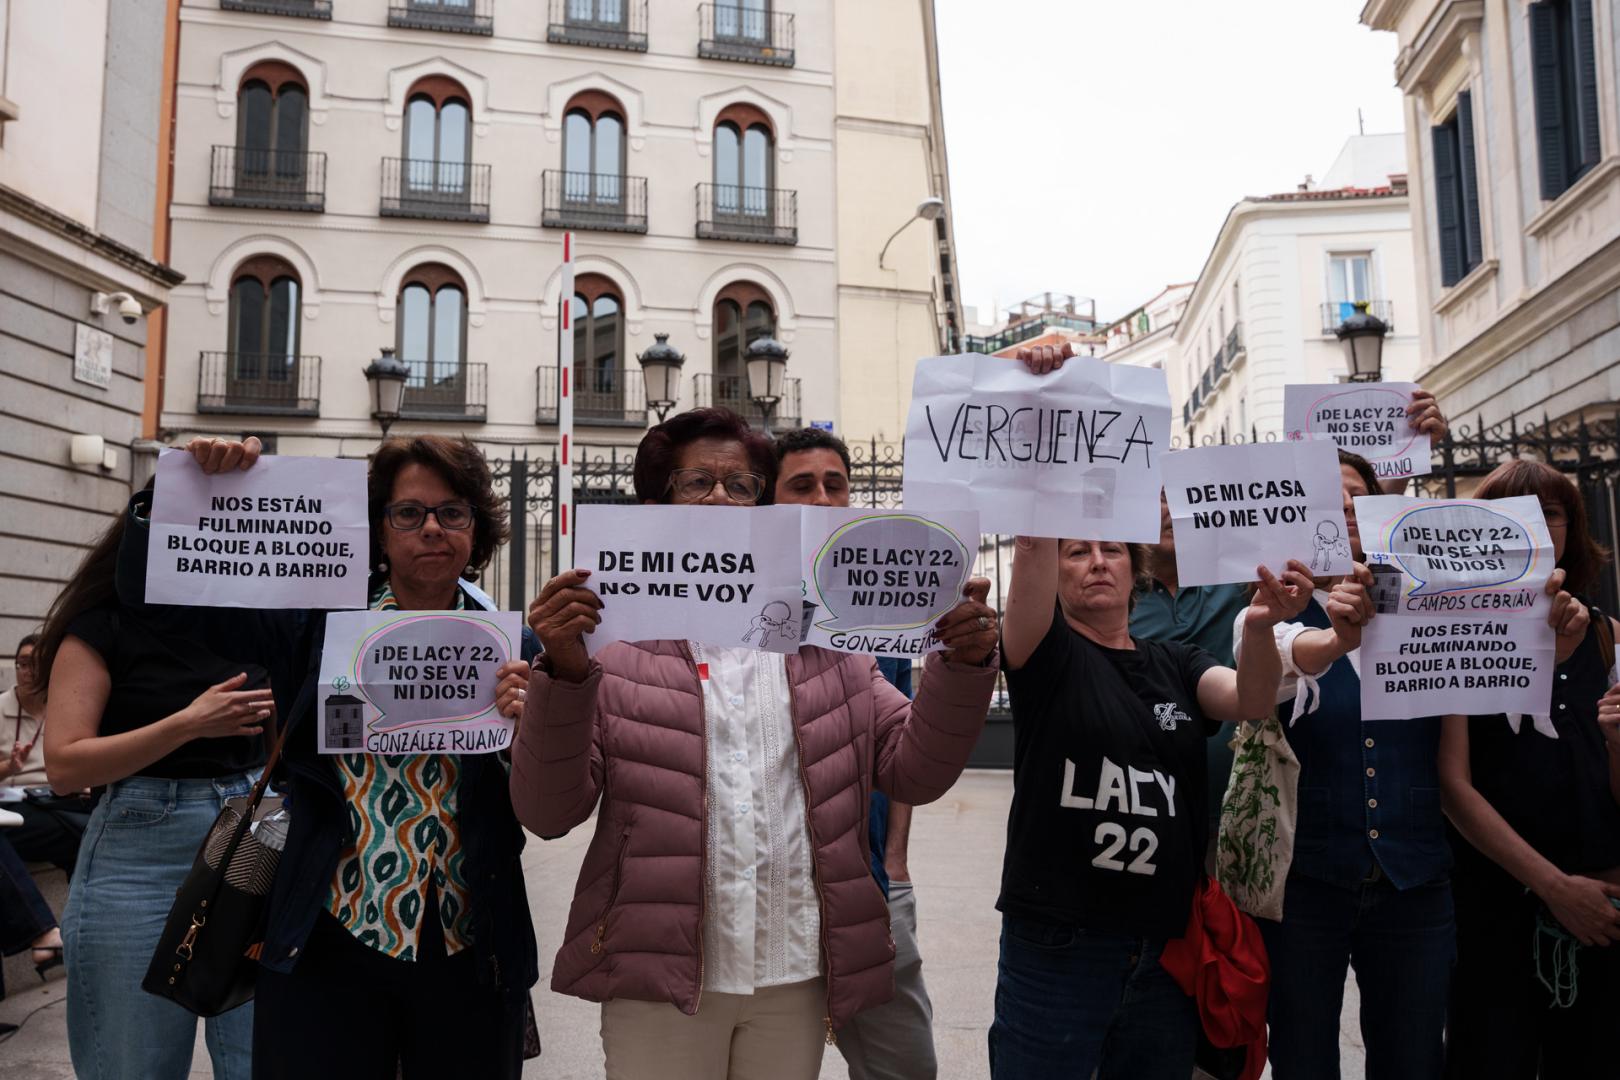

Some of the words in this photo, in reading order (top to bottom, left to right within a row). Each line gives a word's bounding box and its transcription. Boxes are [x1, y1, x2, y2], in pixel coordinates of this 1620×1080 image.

[1317, 409, 1341, 422] ¡DE
[1345, 408, 1383, 419] LACY
[1327, 422, 1349, 433] NO
[1352, 421, 1370, 432] SE
[1374, 421, 1395, 432] VA
[1351, 434, 1392, 446] DIOS!
[1186, 485, 1218, 504] DE
[1220, 484, 1244, 501] MI
[1248, 480, 1306, 500] CASA
[211, 496, 253, 512] NOS
[258, 495, 322, 513] ESTÁN
[198, 517, 332, 535] FULMINANDO
[1193, 510, 1226, 529] NO
[1230, 509, 1259, 527] ME
[1263, 506, 1307, 525] VOY
[1403, 526, 1432, 542] ¡DE
[1437, 528, 1483, 542] LACY
[1490, 527, 1519, 541] 22,
[167, 535, 250, 555] BLOQUE
[254, 541, 267, 555] A
[272, 541, 354, 558] BLOQUE,
[1417, 544, 1444, 556] NO
[1448, 545, 1472, 558] SE
[1475, 544, 1504, 557] VA
[599, 551, 634, 572] DE
[641, 552, 674, 573] MI
[681, 552, 755, 573] CASA
[833, 547, 867, 567] ¡DE
[873, 548, 926, 566] LACY
[929, 550, 959, 567] 22,
[1427, 558, 1448, 570] NI
[1452, 558, 1505, 572] DIOS!
[176, 558, 254, 576] BARRIO
[258, 563, 271, 577] A
[276, 563, 347, 578] BARRIO
[848, 569, 878, 586] NO
[883, 570, 913, 587] SE
[915, 571, 940, 588] VA
[600, 582, 641, 595] NO
[648, 583, 688, 598] ME
[696, 583, 755, 603] VOY
[851, 591, 874, 606] NI
[878, 591, 936, 607] DIOS!
[1406, 594, 1465, 611] CAMPOS
[1471, 589, 1538, 610] CEBRIÁN
[1411, 625, 1446, 638] NOS
[1450, 621, 1508, 635] ESTÁN
[374, 646, 408, 664] ¡DE
[413, 646, 465, 661] LACY
[470, 646, 499, 663] 22,
[1399, 641, 1516, 655] FULMINANDO
[389, 666, 418, 681] NO
[423, 665, 447, 681] SE
[453, 665, 479, 680] VA
[1376, 659, 1443, 675] BLOQUE
[1446, 658, 1456, 671] A
[1460, 657, 1537, 671] BLOQUE,
[394, 685, 414, 699] NI
[420, 684, 476, 699] DIOS!
[1385, 676, 1446, 693] BARRIO
[1449, 675, 1459, 688] A
[1464, 675, 1530, 689] BARRIO
[367, 730, 446, 752] GONZÁLEZ
[450, 728, 508, 751] RUANO
[1060, 756, 1176, 817] LACY
[1092, 822, 1159, 876] 22
